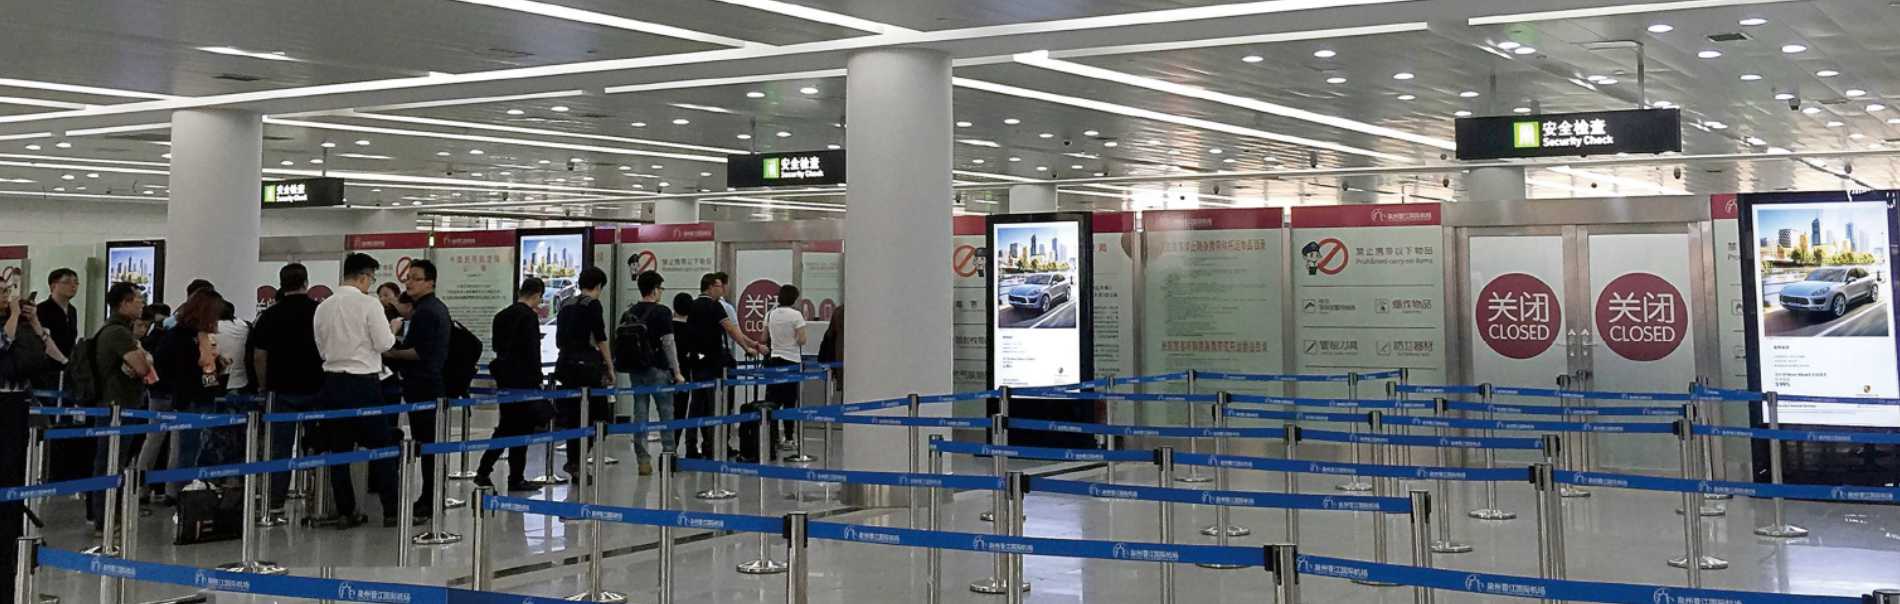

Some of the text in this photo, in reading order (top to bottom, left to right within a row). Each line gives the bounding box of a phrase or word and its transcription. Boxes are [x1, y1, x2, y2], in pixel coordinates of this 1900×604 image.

[1543, 119, 1606, 136] 安全检查
[1542, 135, 1614, 147] Security Check
[781, 156, 820, 170] 安全检查
[1488, 292, 1549, 323] 关闭
[1609, 292, 1675, 324] 关闭
[1489, 324, 1549, 341] CLOSED
[1609, 325, 1676, 342] CLOSED
